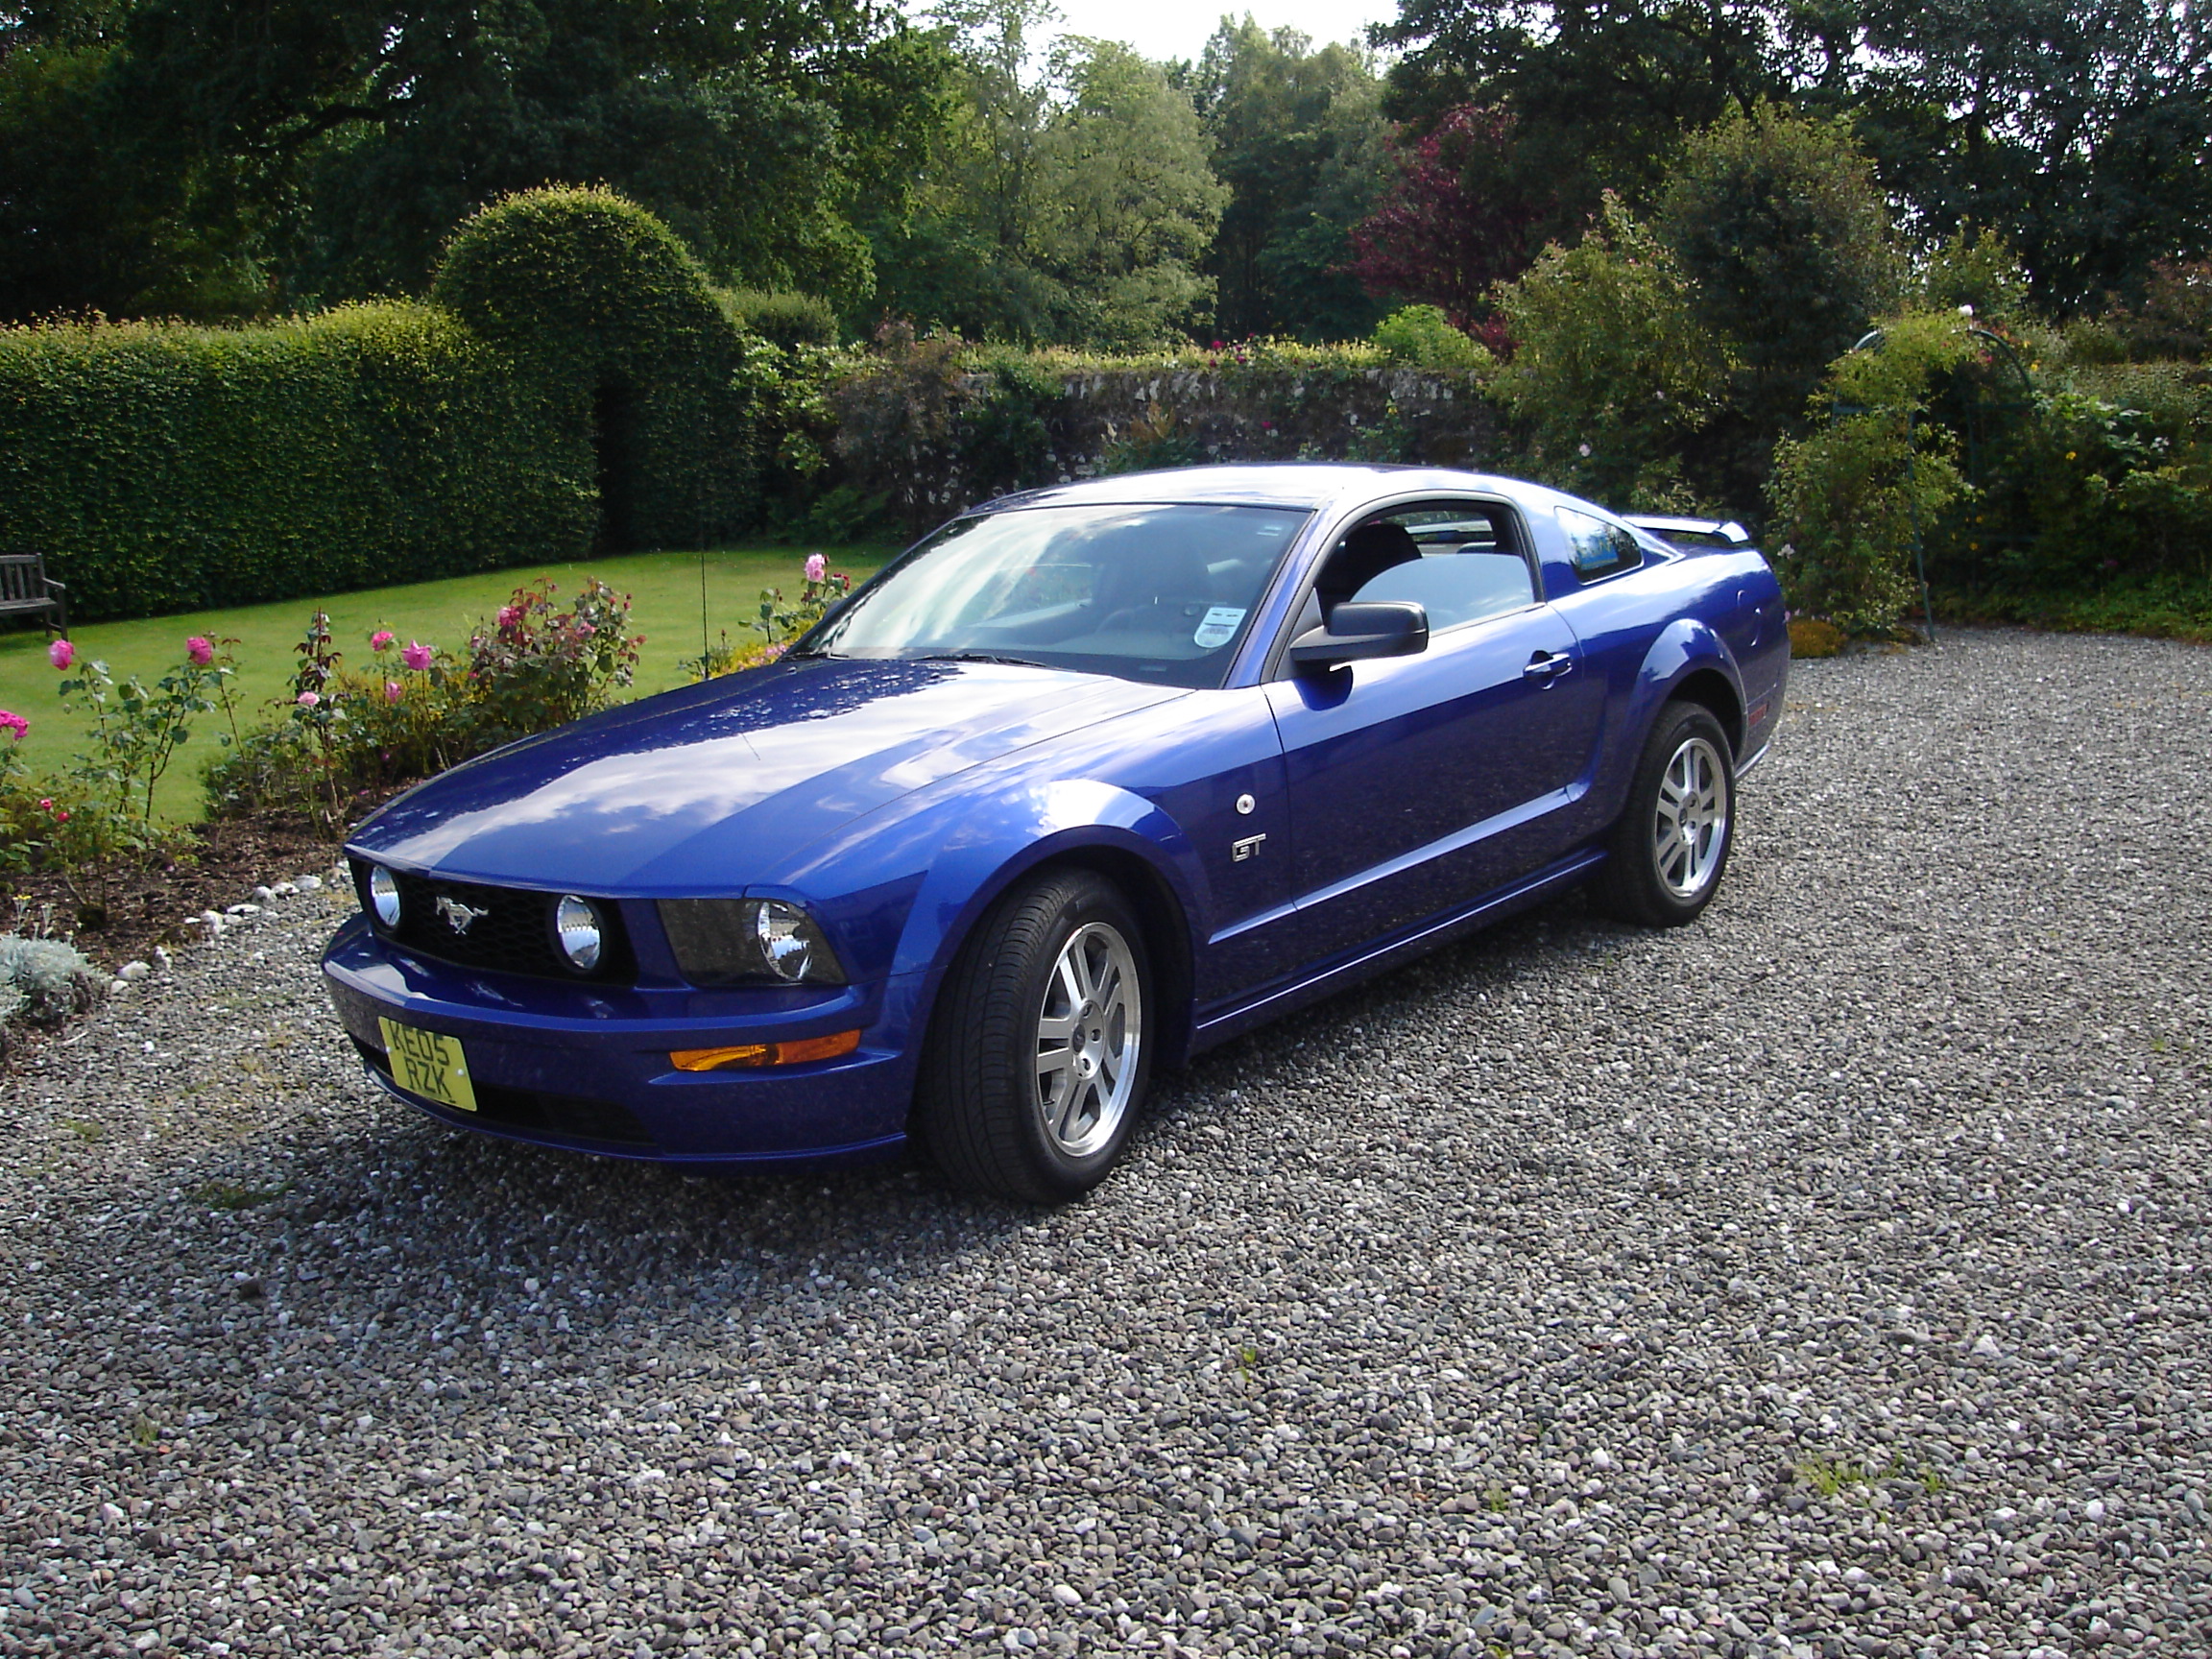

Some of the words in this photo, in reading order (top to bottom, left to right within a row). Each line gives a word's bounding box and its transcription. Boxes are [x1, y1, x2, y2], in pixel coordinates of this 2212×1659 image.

[1232, 832, 1266, 862] GT
[388, 1019, 450, 1066] KE05
[404, 1056, 452, 1097] RZK
